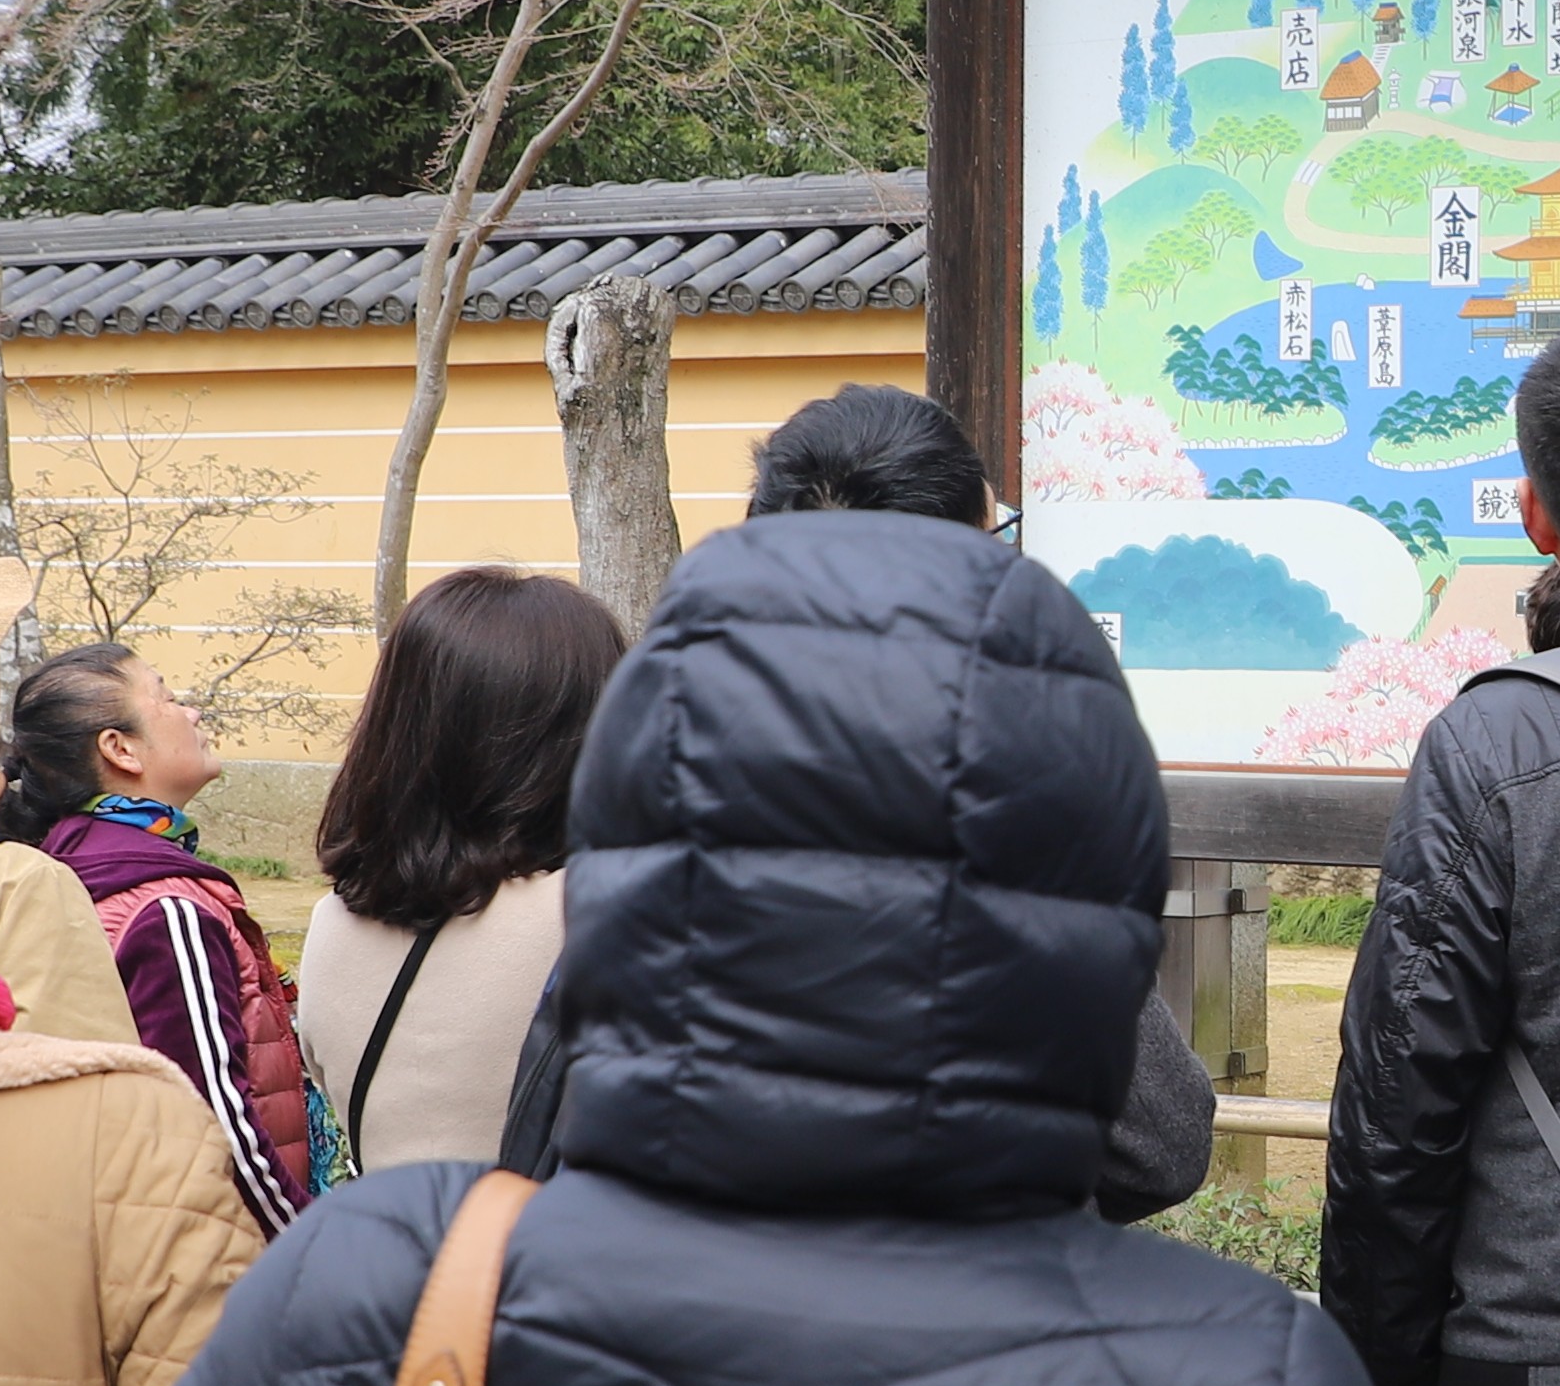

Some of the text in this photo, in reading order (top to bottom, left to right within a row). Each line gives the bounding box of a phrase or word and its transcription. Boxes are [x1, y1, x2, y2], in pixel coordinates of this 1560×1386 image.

[1285, 12, 1314, 85] 売店
[1436, 191, 1478, 282] 金閣
[1284, 281, 1308, 356] 赤松石
